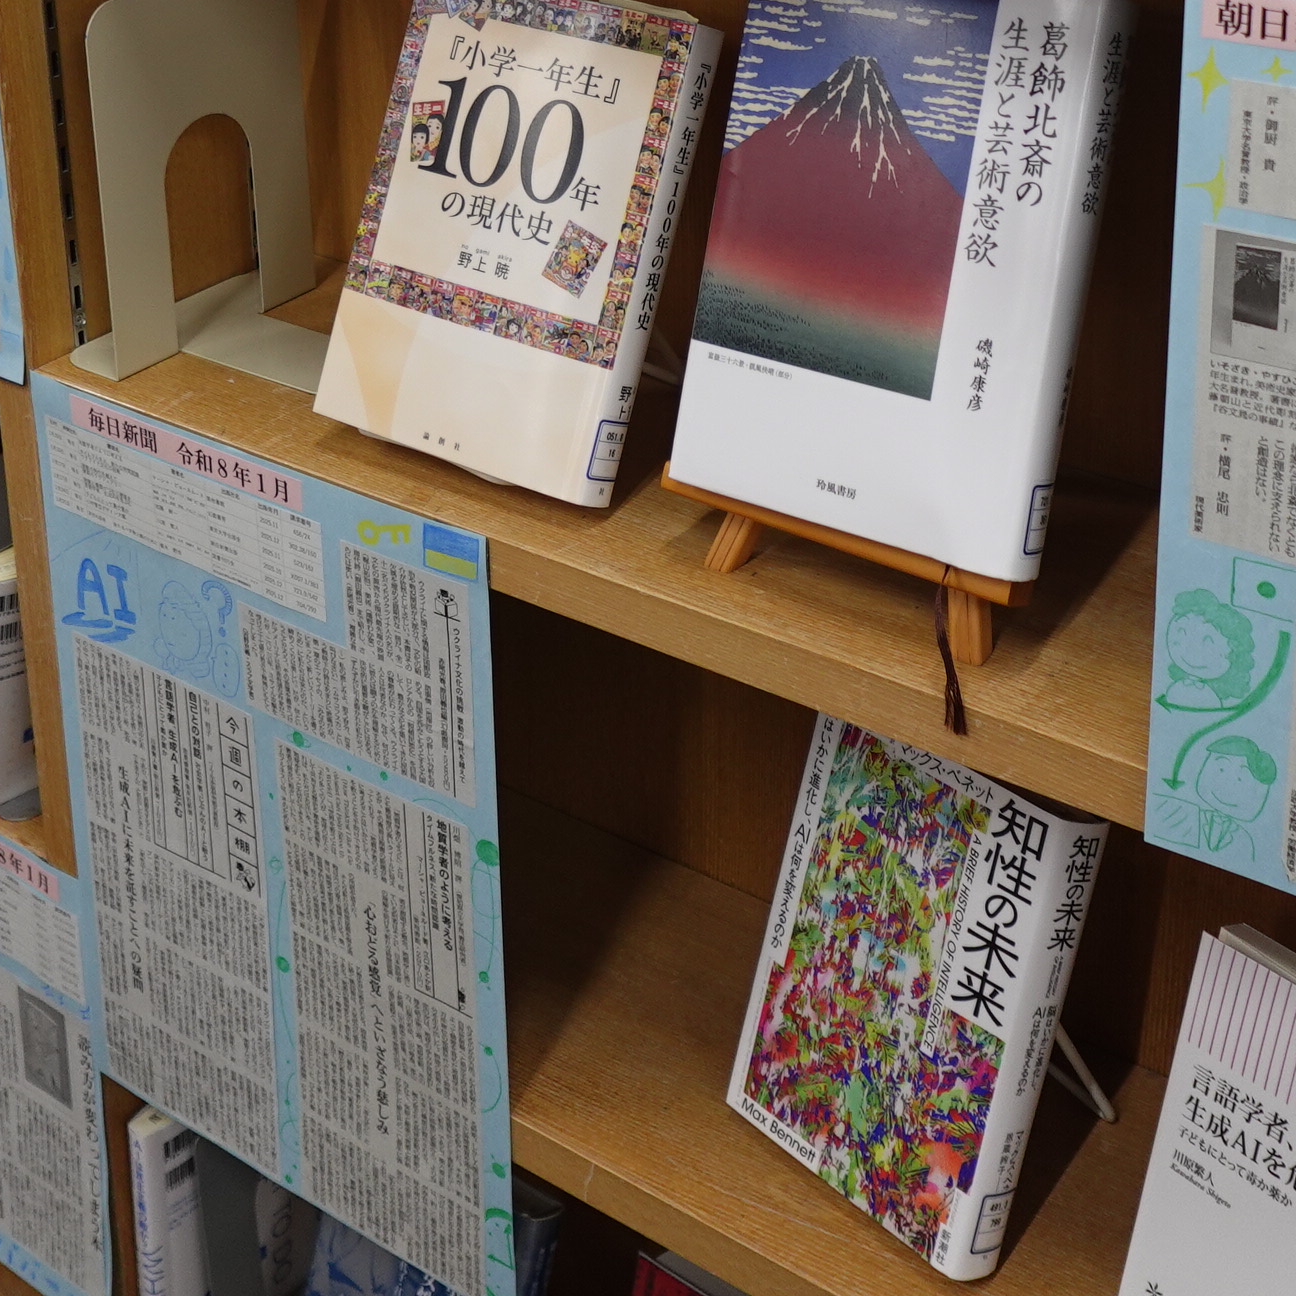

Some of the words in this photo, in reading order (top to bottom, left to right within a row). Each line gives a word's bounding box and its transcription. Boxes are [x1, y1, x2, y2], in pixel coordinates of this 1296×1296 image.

[448, 35, 621, 105] 『小学一年生』
[417, 76, 586, 204] 100
[569, 178, 602, 212] 年
[963, 17, 1029, 269] 生涯と芸術意欲
[1015, 20, 1071, 208] 葛飾北斎の
[1080, 31, 1124, 217] 生涯と芸術意欲
[441, 191, 554, 245] の現代史
[457, 249, 487, 275] 野上
[965, 337, 994, 413] 磯崎康彦
[88, 407, 159, 455] 毎日新聞
[176, 441, 290, 504] 令和8年1月
[422, 430, 462, 453] 論創社
[816, 477, 857, 501] 玲風書房
[76, 556, 138, 627] AI
[951, 798, 1050, 1028] 知性の未来
[1046, 833, 1100, 953] 知性の未来
[740, 1098, 771, 1125] Max
[769, 1120, 819, 1166] Bennett
[1189, 1062, 1295, 1152] 言語学者、
[1171, 1148, 1216, 1188] 川原繁人
[1176, 1125, 1294, 1209] 子どもにとって毒か薬か
